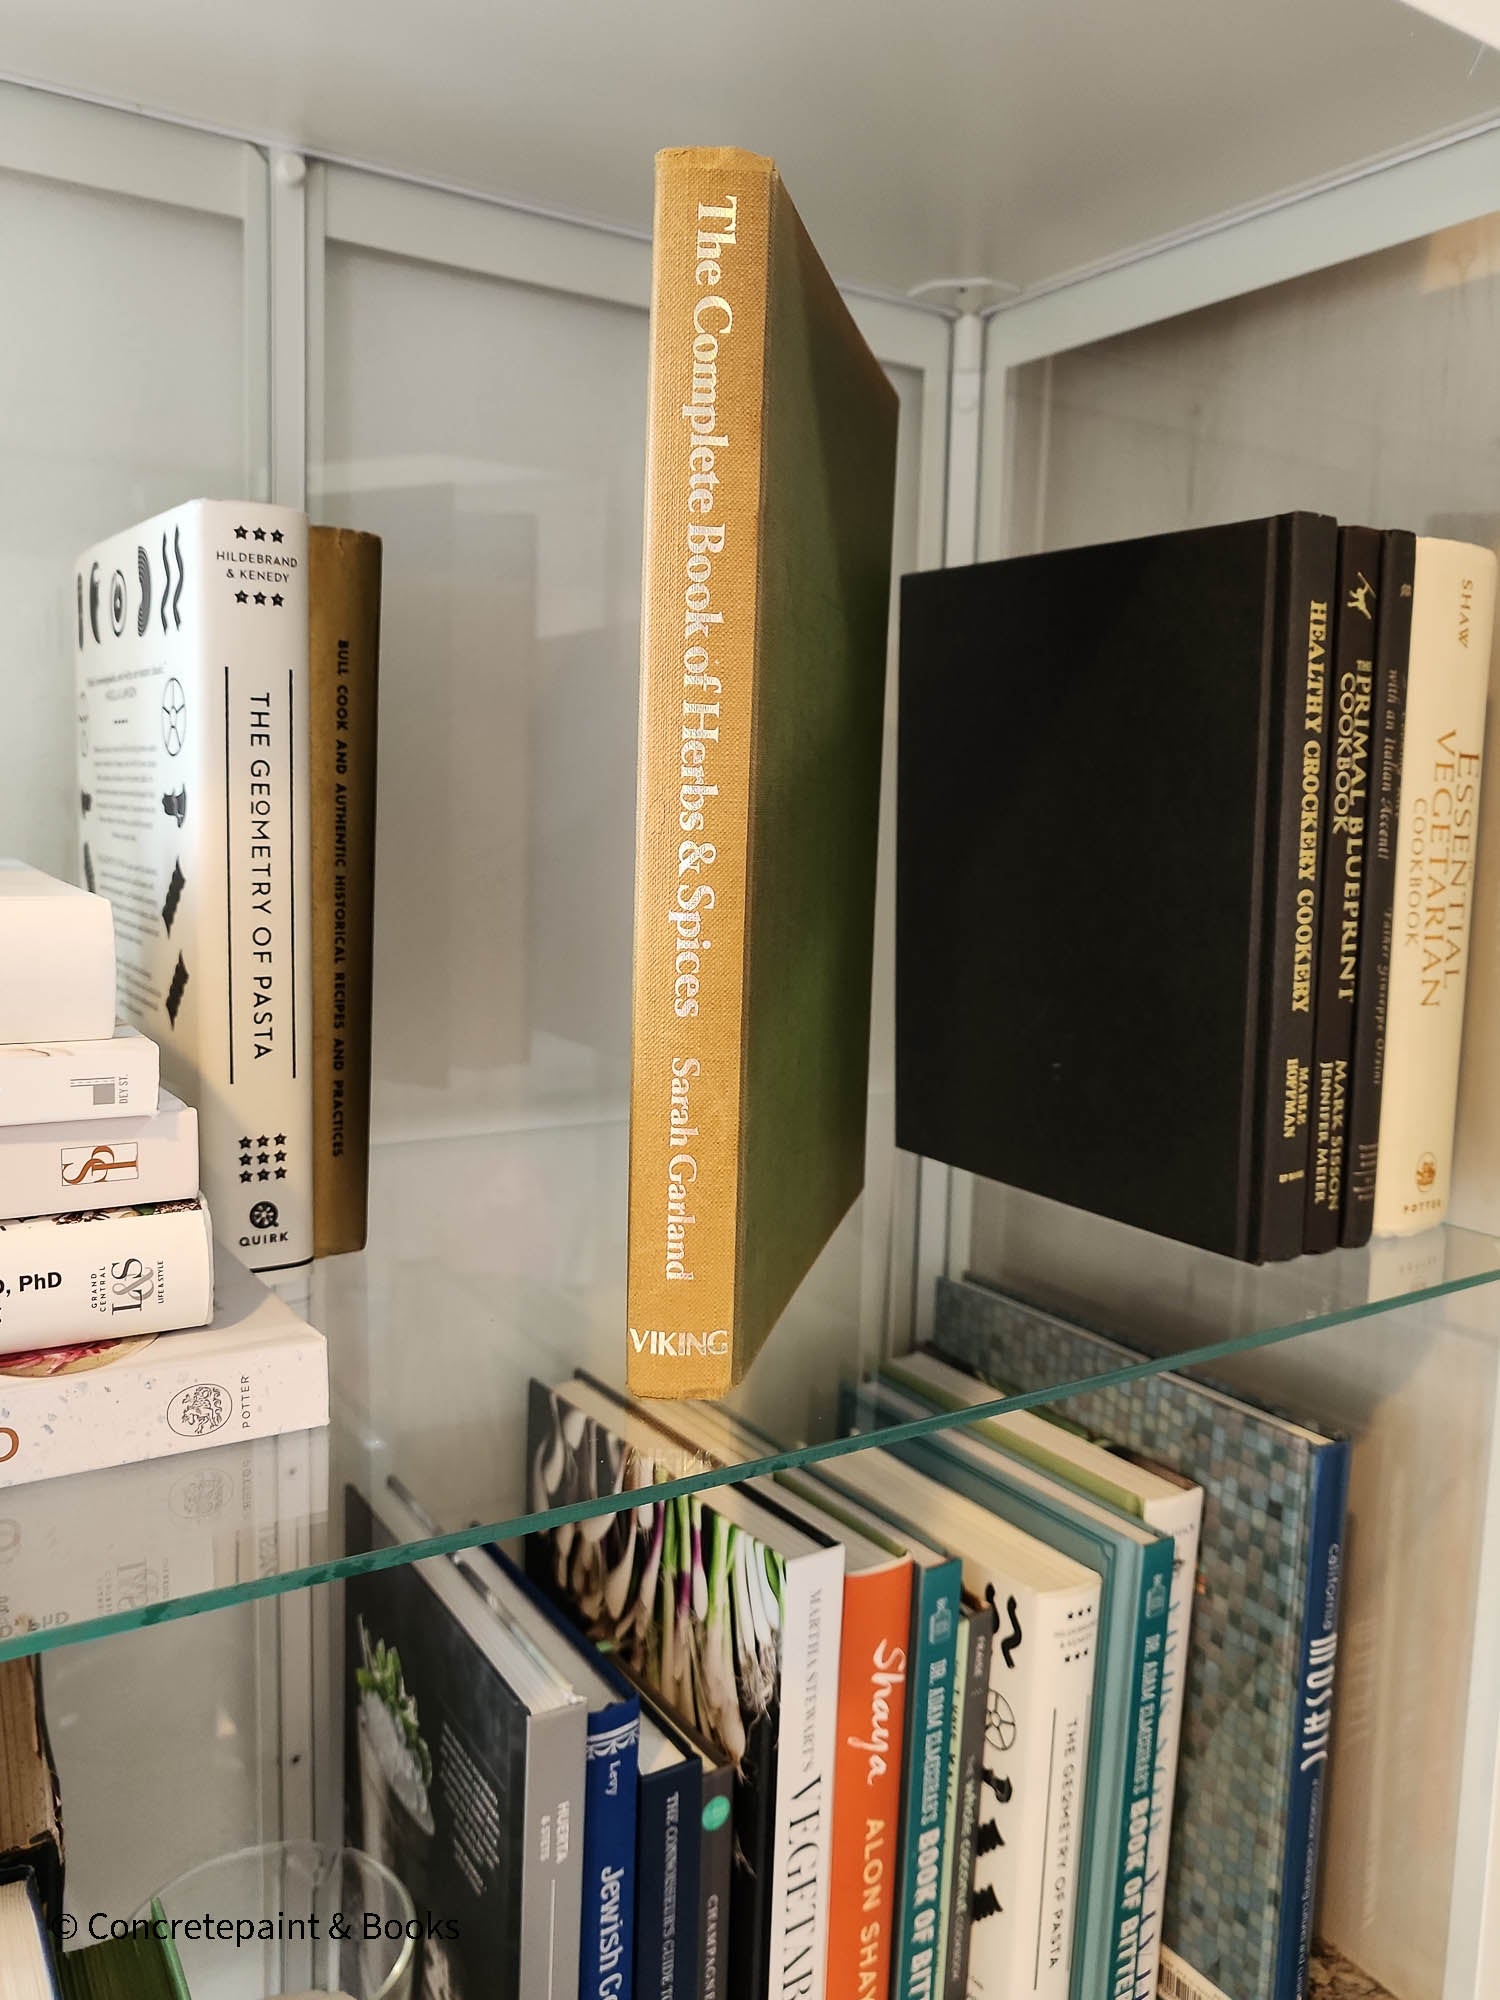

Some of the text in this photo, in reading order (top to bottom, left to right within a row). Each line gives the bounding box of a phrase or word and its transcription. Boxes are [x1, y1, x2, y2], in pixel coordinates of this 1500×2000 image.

[216, 551, 298, 568] HILDEBRAND
[226, 569, 290, 583] & KENEDY
[668, 194, 738, 1019] The Complete Book of Herbs & Spices
[1458, 579, 1474, 649] SHAW
[1386, 709, 1397, 730] an
[1387, 669, 1398, 703] with
[1333, 672, 1356, 834] COOKBOOK
[1350, 673, 1373, 805] PRIMAL
[1382, 737, 1395, 791] Italian
[1292, 600, 1327, 1013] HEALTHY CROCKERY COOKERY
[250, 693, 272, 1060] THE GEOMETRY OF PASTA
[332, 640, 349, 1157] BULL COOK AND AUTHENTIC HISTORICAL RECIPES AND PRACTICES
[1405, 798, 1427, 946] COOKBOOK
[1421, 729, 1456, 1006] VEGETARIAN
[1444, 754, 1479, 988] ESSENTIAL
[1338, 816, 1364, 1002] BLUEPRINT
[119, 1087, 128, 1104] DEY
[1314, 1062, 1333, 1204] JENNIFER MEIER
[1328, 1060, 1347, 1210] MARK SISSON
[665, 1056, 701, 1281] Sarah Garland
[239, 1231, 288, 1247] QUIRK
[19, 1271, 62, 1292] PhD
[629, 1328, 729, 1357] VIKING
[242, 1375, 250, 1428] POTTER
[1323, 1543, 1340, 1631] california
[807, 1588, 821, 1667] MARTHA
[929, 1658, 947, 1686] DR.
[847, 1638, 906, 1787] Shaya
[605, 1760, 621, 1796] Levy
[666, 1791, 680, 1825] THE
[862, 1818, 885, 1912] ALON
[913, 1827, 940, 1908] BOOK
[1049, 1719, 1078, 1970] THE GEOMETRY OF PASTA
[1124, 1797, 1149, 1874] BOOK
[600, 1866, 624, 1973] Jewish
[911, 1908, 935, 1943] OF
[1121, 1876, 1142, 1909] OF
[660, 1939, 675, 1984] GUIDE
